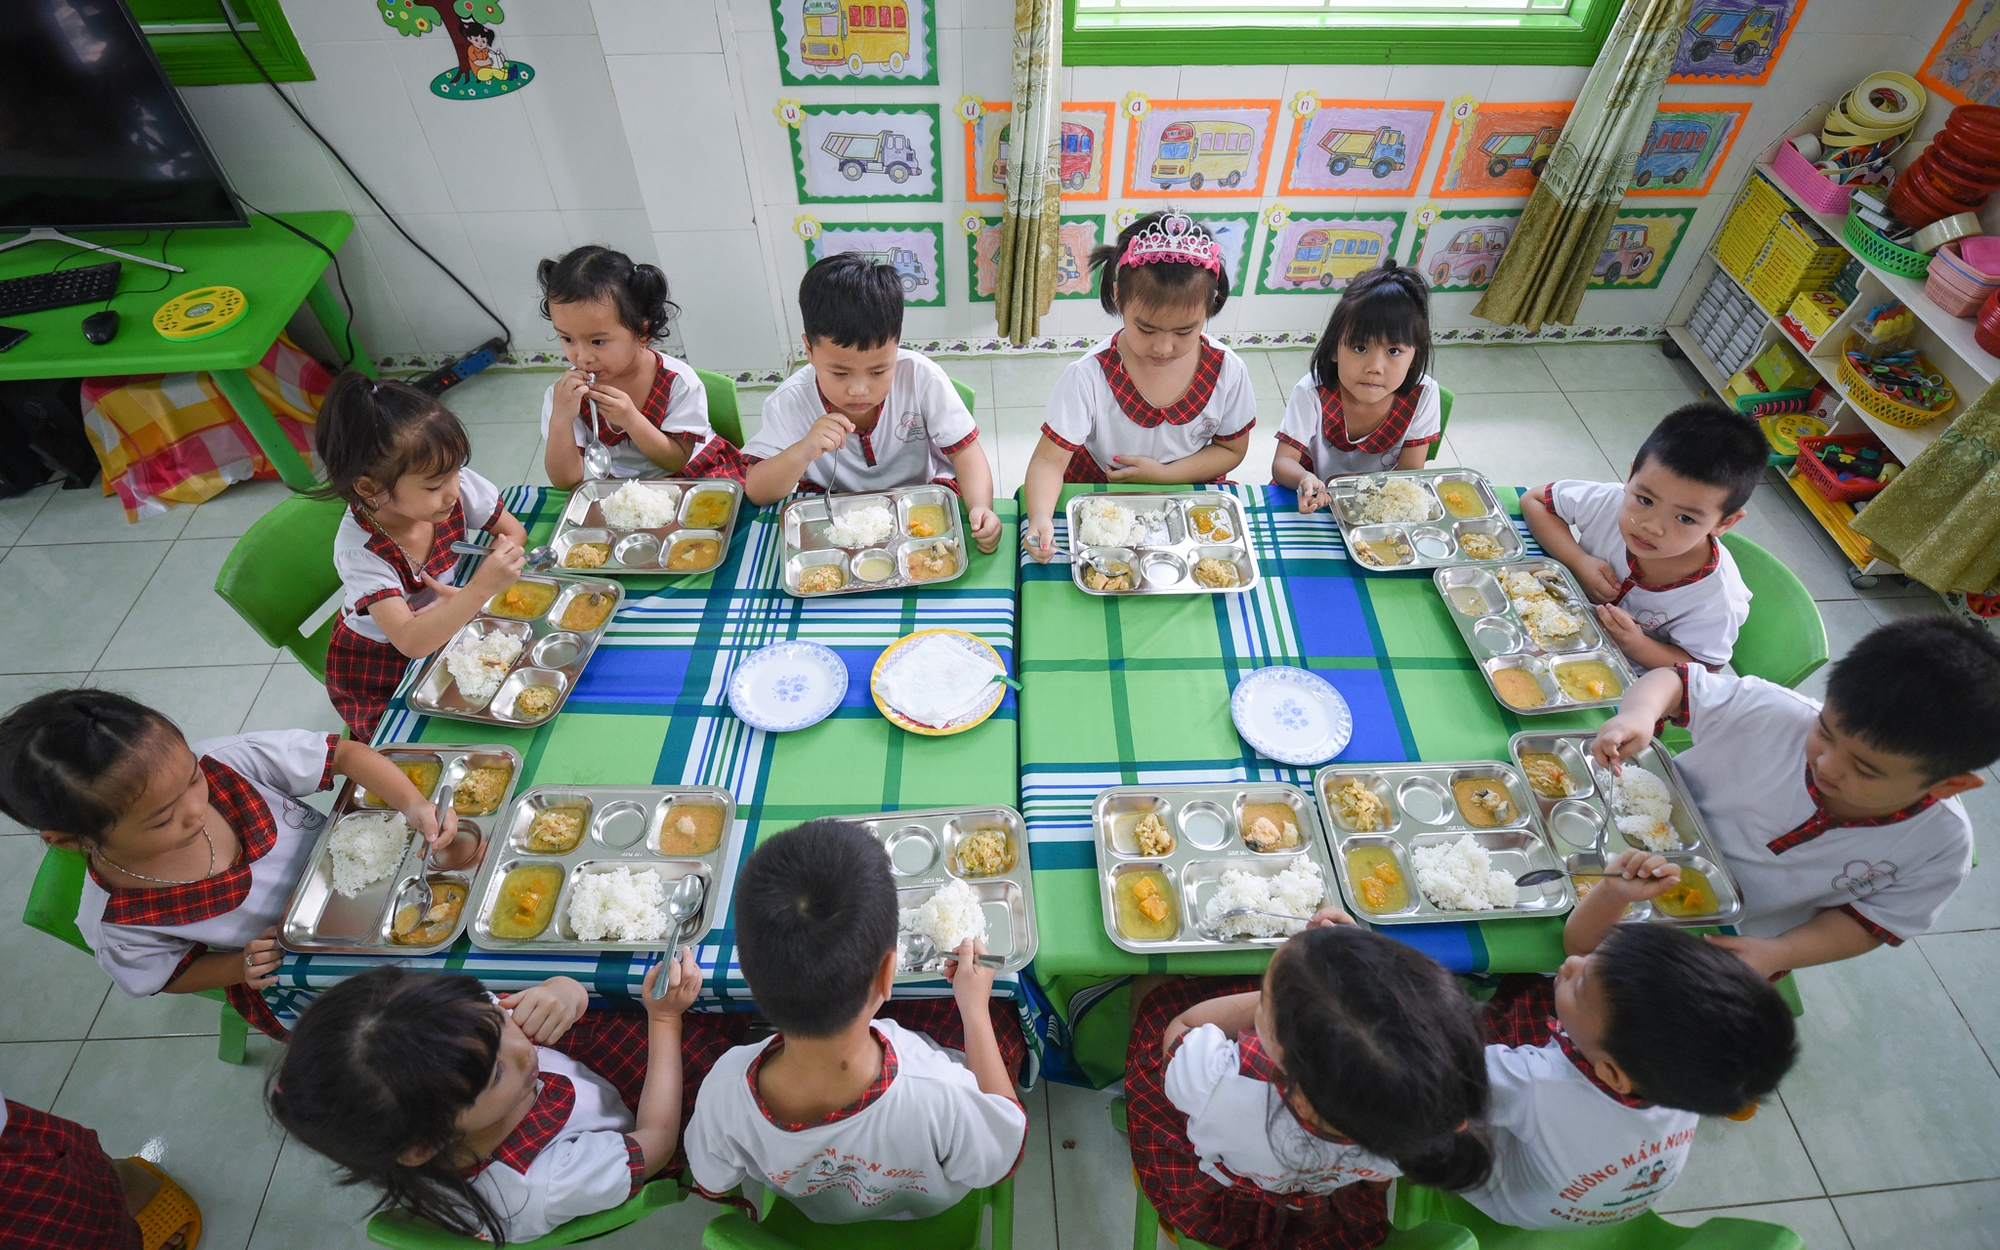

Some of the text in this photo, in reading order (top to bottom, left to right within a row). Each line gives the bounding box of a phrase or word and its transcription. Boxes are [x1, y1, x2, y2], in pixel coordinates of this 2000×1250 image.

[1132, 102, 1141, 112] a
[1301, 101, 1309, 111] n
[1458, 103, 1468, 116] â
[786, 108, 796, 119] u
[804, 224, 813, 235] h
[967, 218, 976, 230] ô
